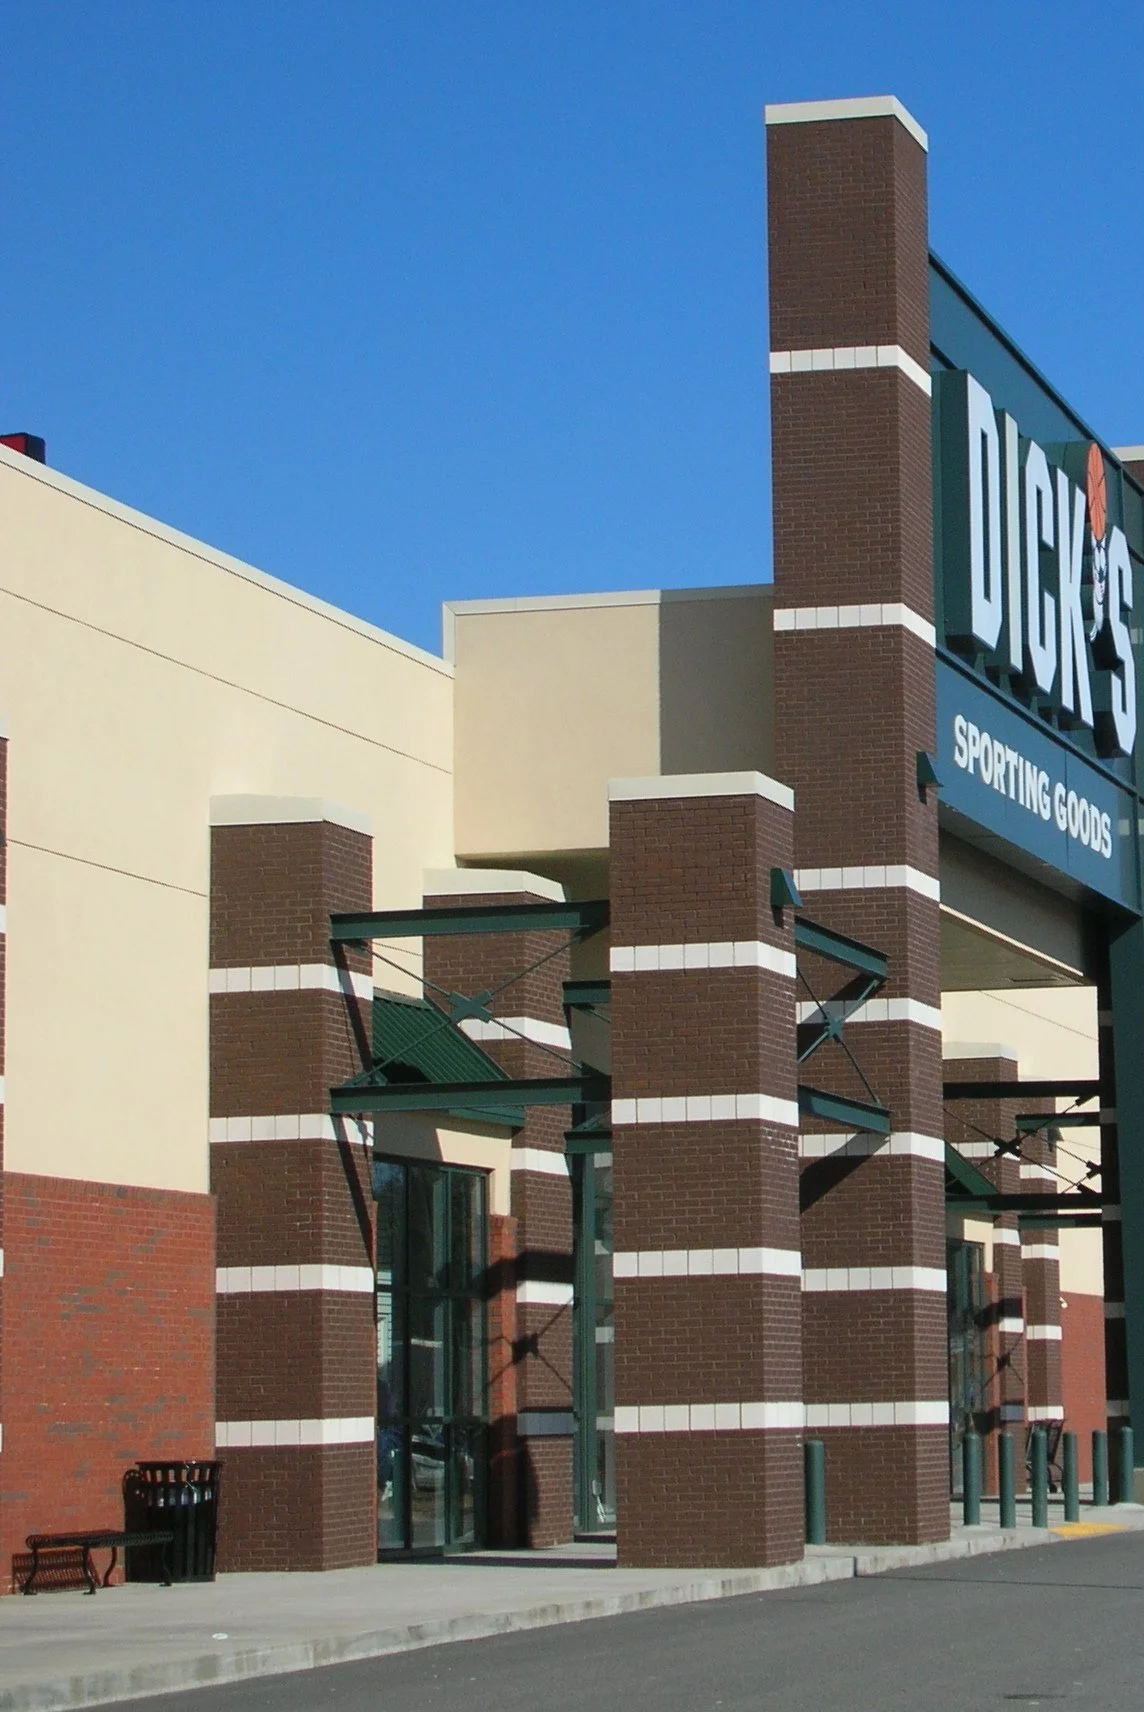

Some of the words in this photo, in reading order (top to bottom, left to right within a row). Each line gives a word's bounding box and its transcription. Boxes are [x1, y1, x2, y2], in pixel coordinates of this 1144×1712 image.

[966, 372, 1137, 757] DICK'S
[954, 714, 1051, 821] SPORTING
[1054, 782, 1113, 859] GOODS
